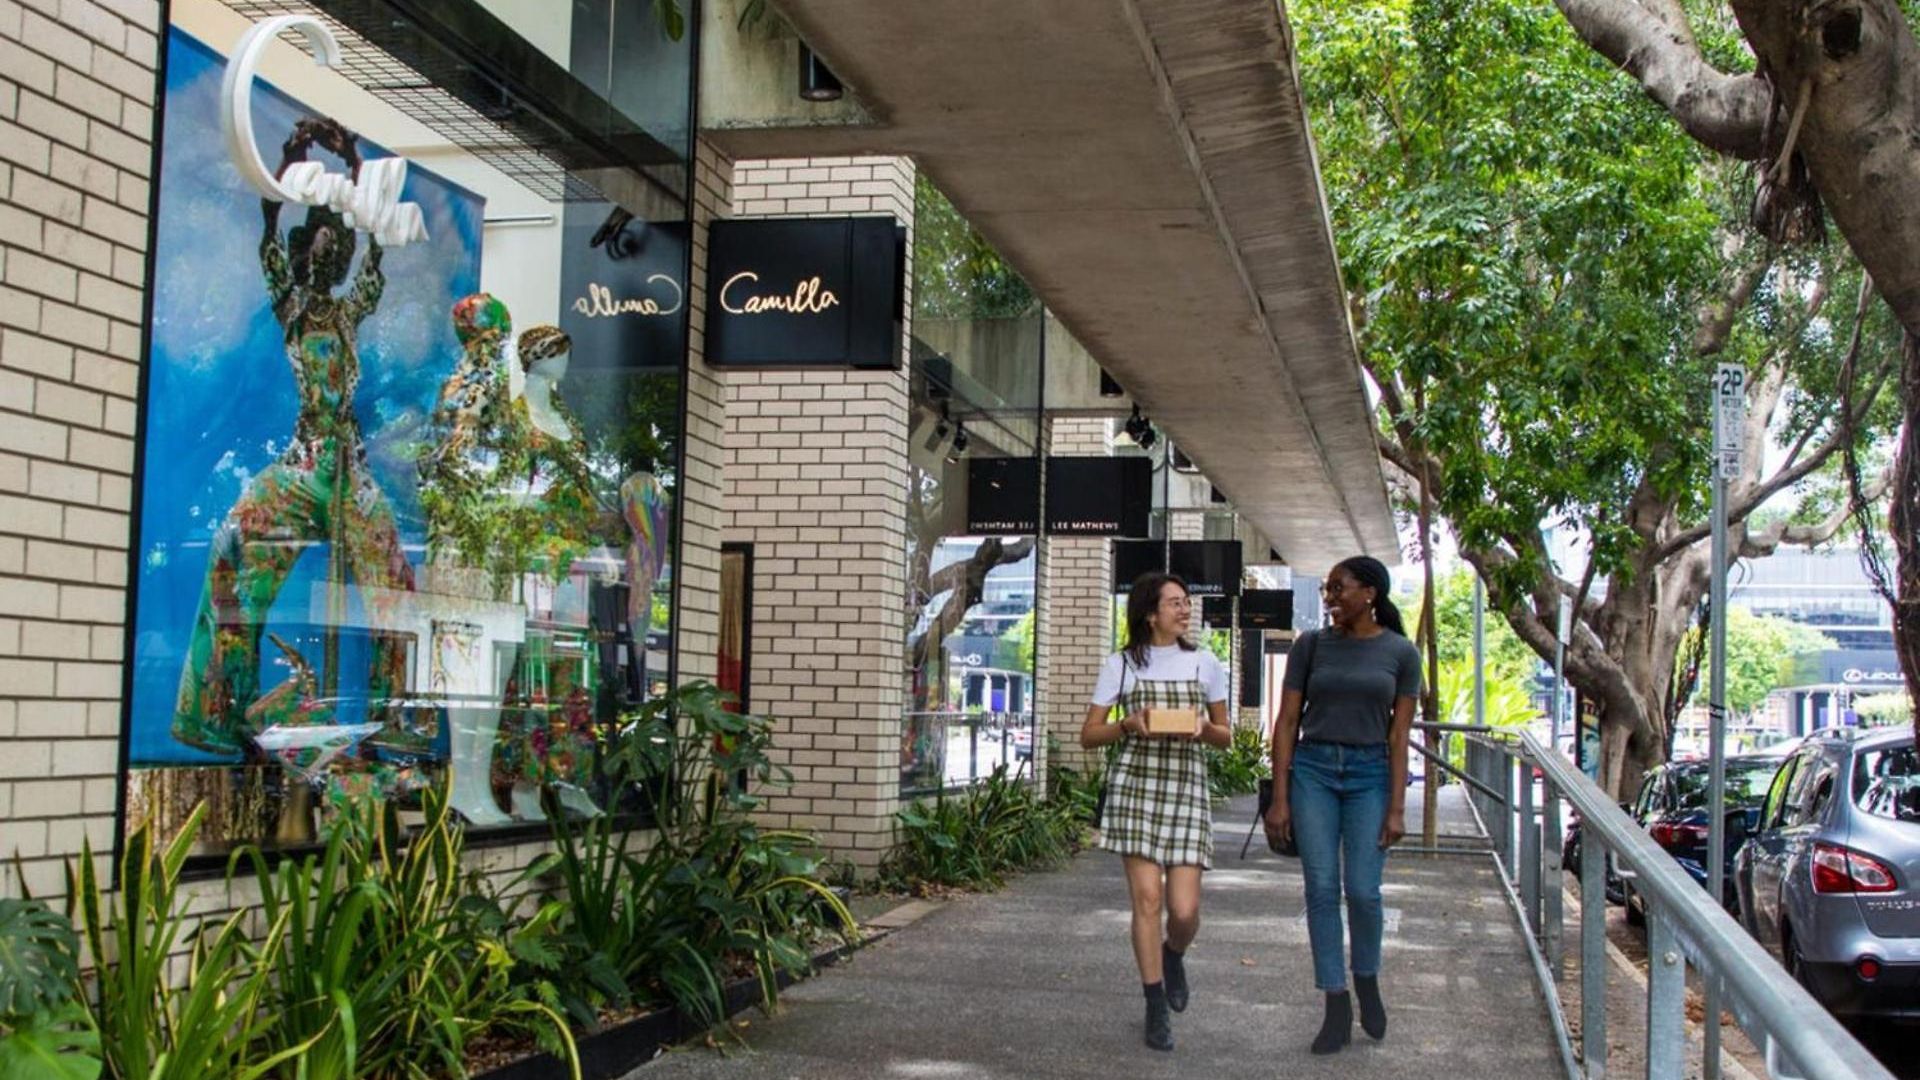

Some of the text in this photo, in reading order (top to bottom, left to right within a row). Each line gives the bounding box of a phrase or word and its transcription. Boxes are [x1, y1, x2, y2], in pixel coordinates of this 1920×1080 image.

[720, 271, 839, 314] Camilla
[1721, 368, 1743, 396] 2P
[1052, 521, 1119, 530] LEE MATHEWS
